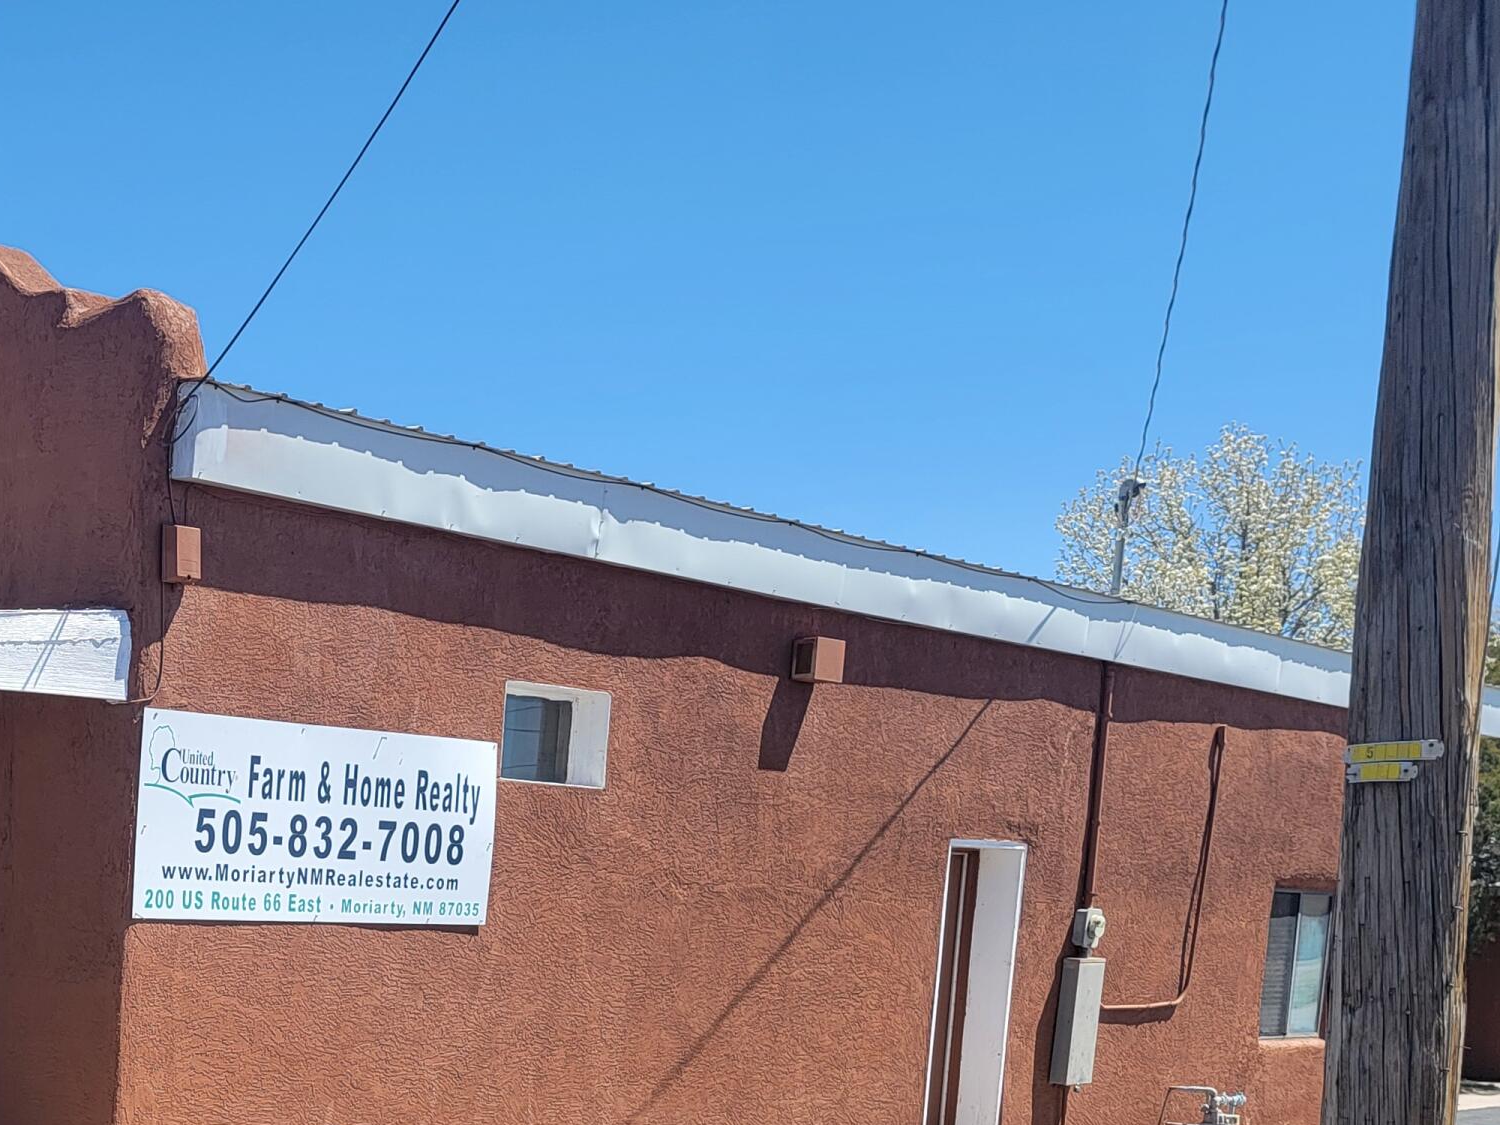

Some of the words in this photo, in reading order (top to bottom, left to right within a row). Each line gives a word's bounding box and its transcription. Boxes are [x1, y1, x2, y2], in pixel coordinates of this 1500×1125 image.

[161, 747, 236, 794] Country
[182, 749, 214, 766] United
[248, 755, 306, 802] Farm
[317, 761, 331, 804] &
[343, 763, 405, 809] Home
[415, 769, 481, 825] Realty
[194, 808, 465, 866] 505-832-7008
[161, 863, 459, 890] www.MoriartyNMRealestate.com
[144, 889, 174, 909] 200
[182, 890, 203, 910] US
[211, 891, 256, 911] Route
[263, 892, 281, 912] 66
[288, 893, 321, 913] East
[341, 898, 406, 918] Moriarty,
[412, 901, 433, 916] NM
[438, 902, 480, 917] 87035
